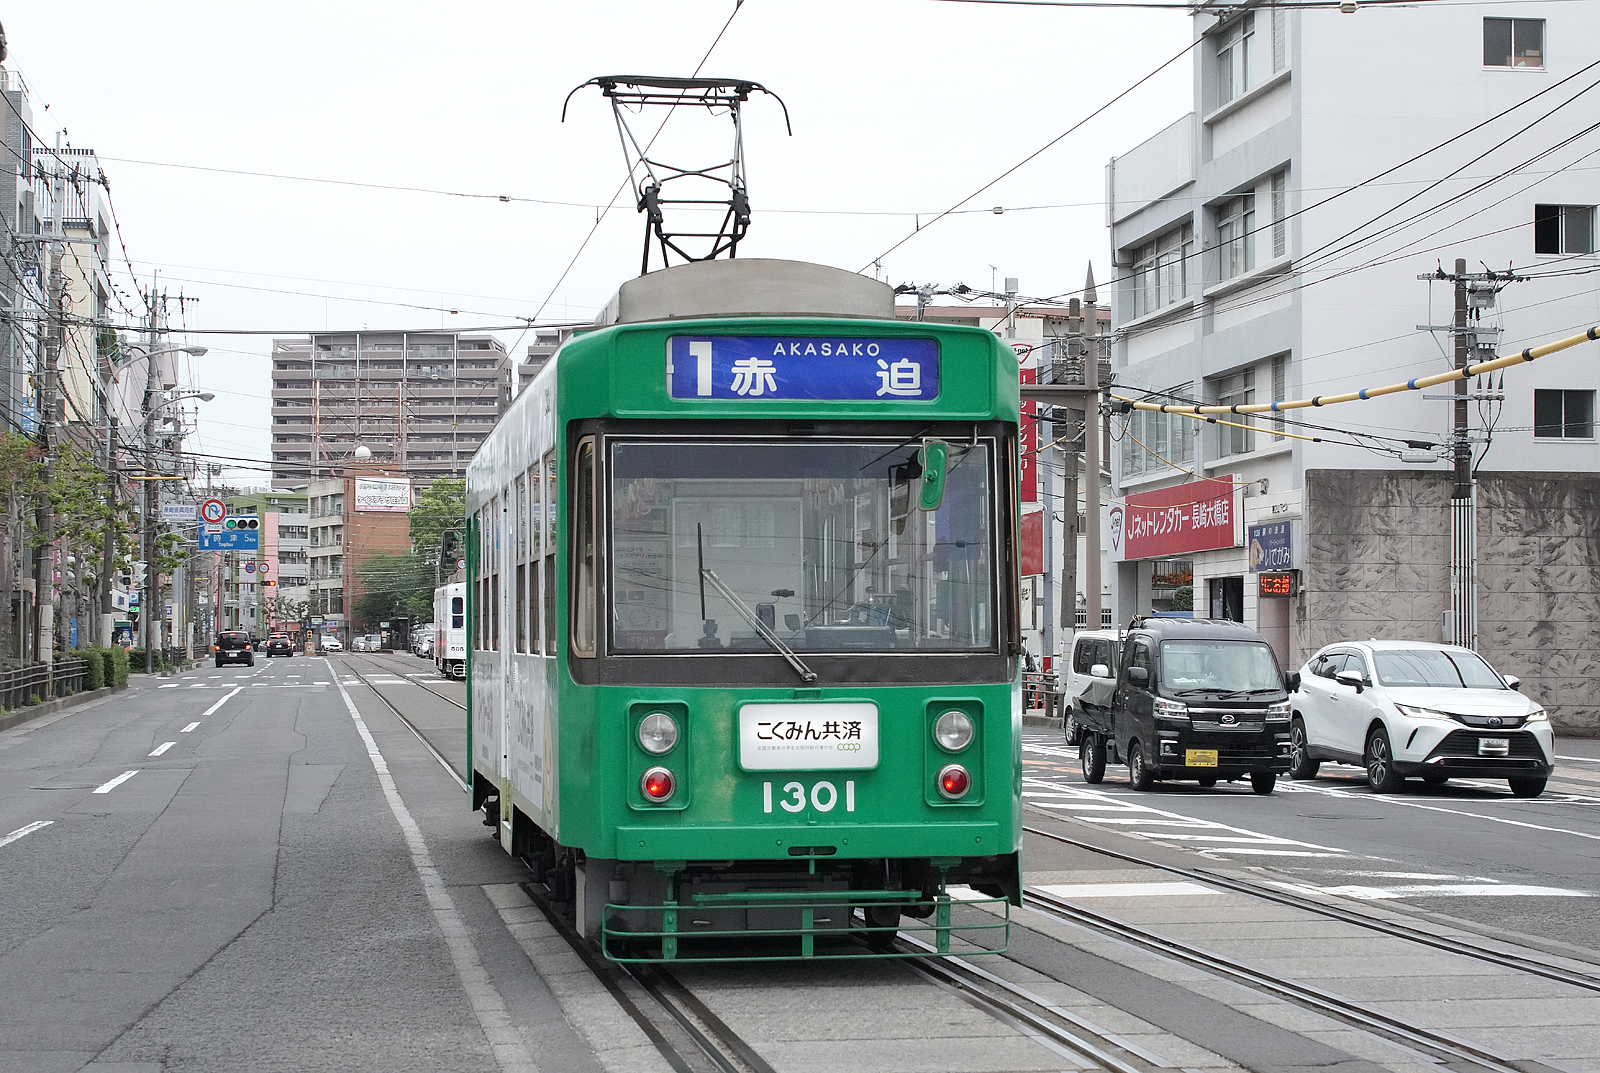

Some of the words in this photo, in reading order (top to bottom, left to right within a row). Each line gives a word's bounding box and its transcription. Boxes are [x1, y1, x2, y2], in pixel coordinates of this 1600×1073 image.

[773, 342, 880, 356] AKASAKO
[689, 341, 712, 396] 1
[730, 356, 922, 396] 赤迫
[1127, 506, 1189, 540] Jネットレンタカー
[1191, 498, 1229, 530] 長崎大橋店
[757, 721, 861, 740] こくみん共済
[837, 742, 861, 753] coop
[763, 780, 855, 813] 1301
